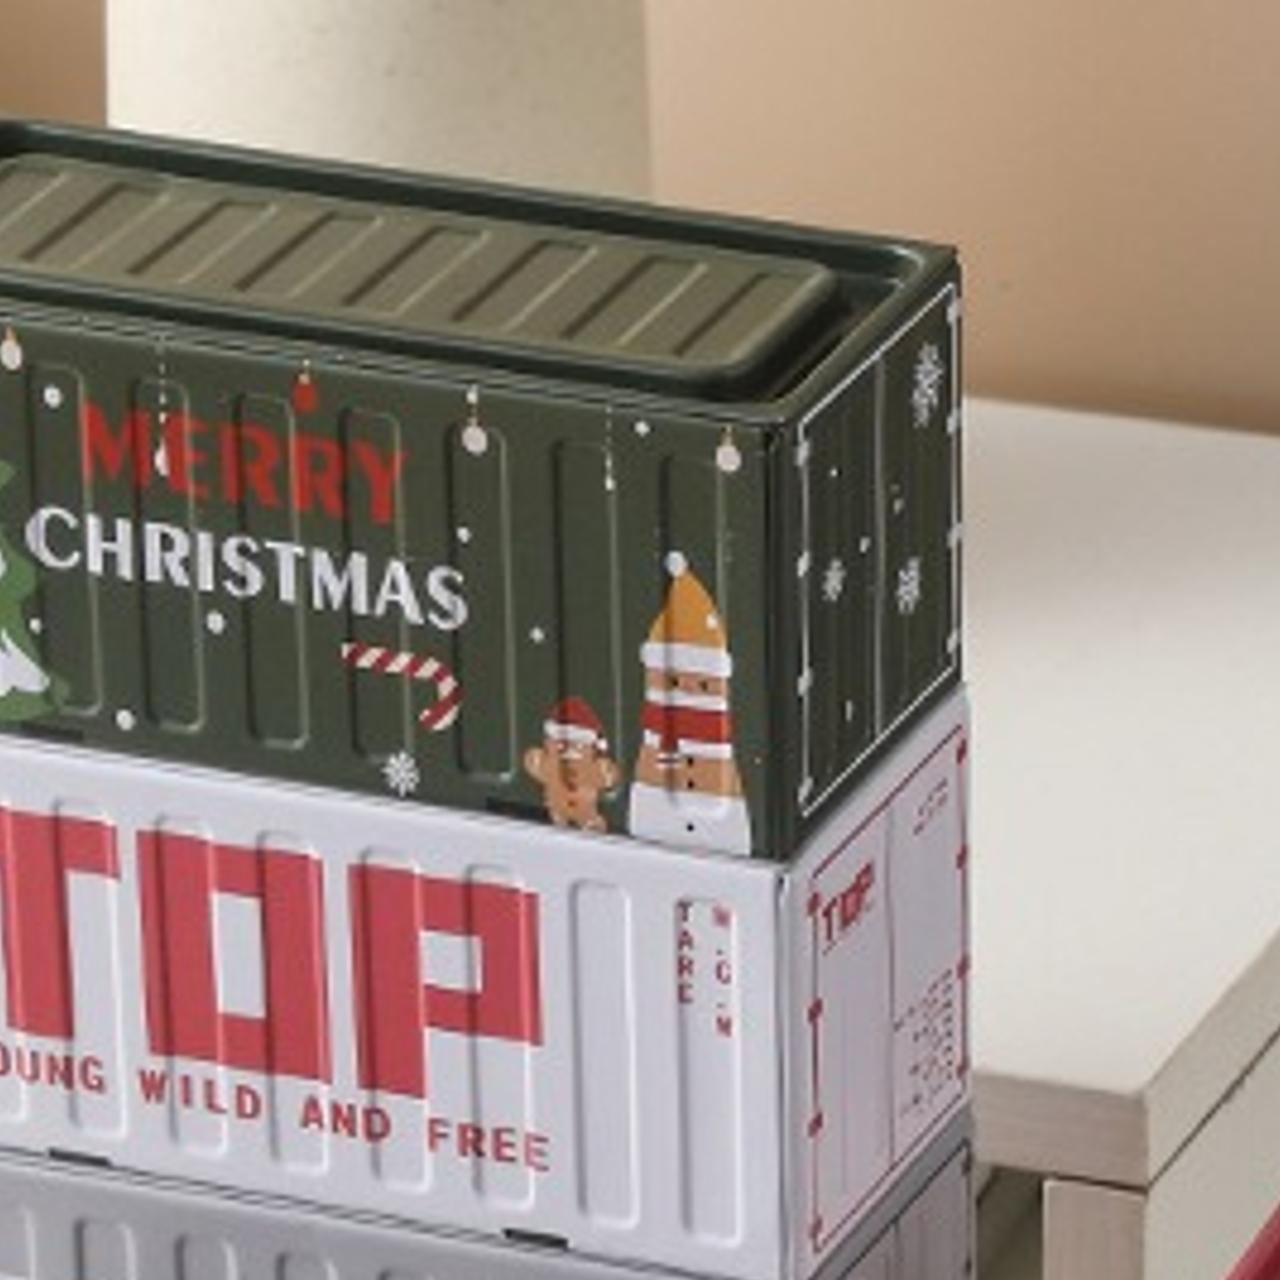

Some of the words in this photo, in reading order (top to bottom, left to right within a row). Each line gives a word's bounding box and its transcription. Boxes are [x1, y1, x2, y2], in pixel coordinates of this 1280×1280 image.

[80, 400, 406, 527] MERRY
[25, 505, 470, 634] CHRISTMAS
[139, 1068, 262, 1122] WILD
[302, 1097, 392, 1144] AND
[426, 1115, 550, 1172] FREE
